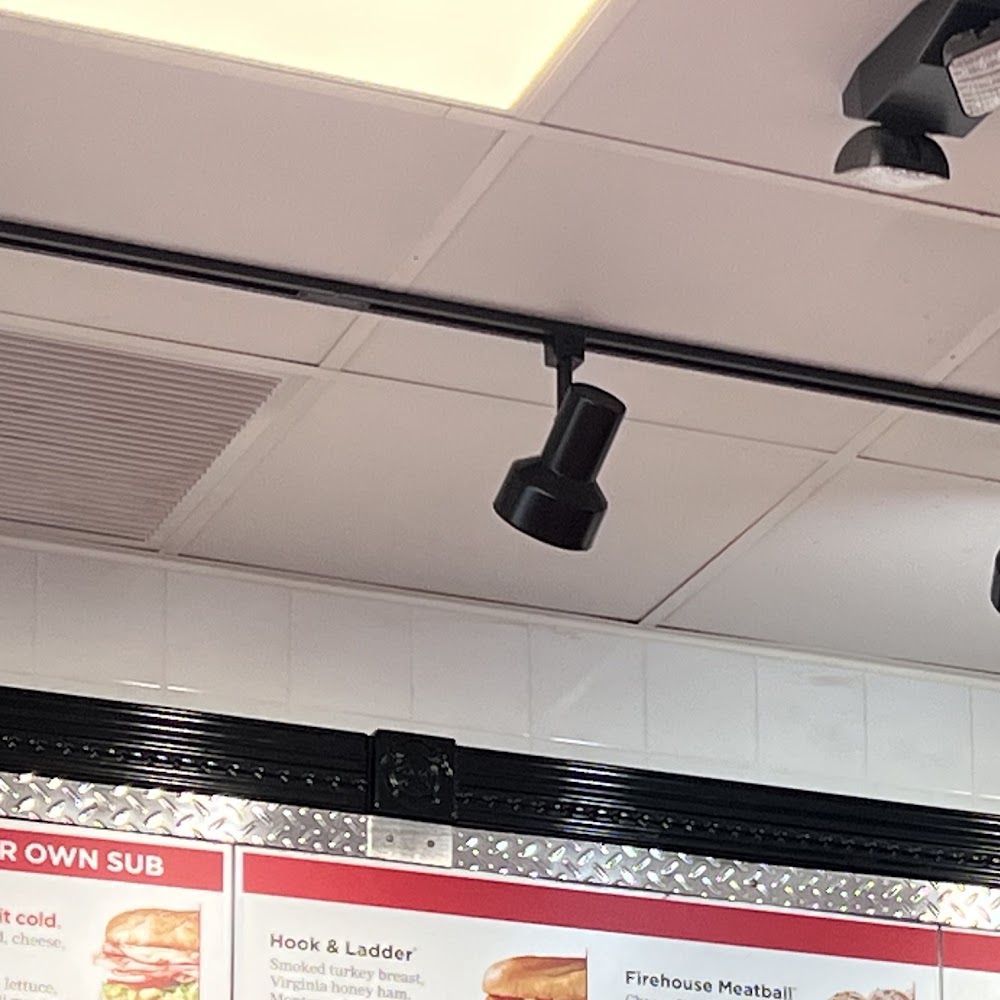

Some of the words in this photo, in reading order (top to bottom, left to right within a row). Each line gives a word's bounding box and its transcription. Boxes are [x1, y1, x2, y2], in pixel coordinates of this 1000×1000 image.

[25, 843, 98, 871] OWN
[107, 850, 164, 876] SUB
[270, 934, 319, 953] Hook
[326, 939, 338, 955] &
[626, 971, 712, 993] Firehouse
